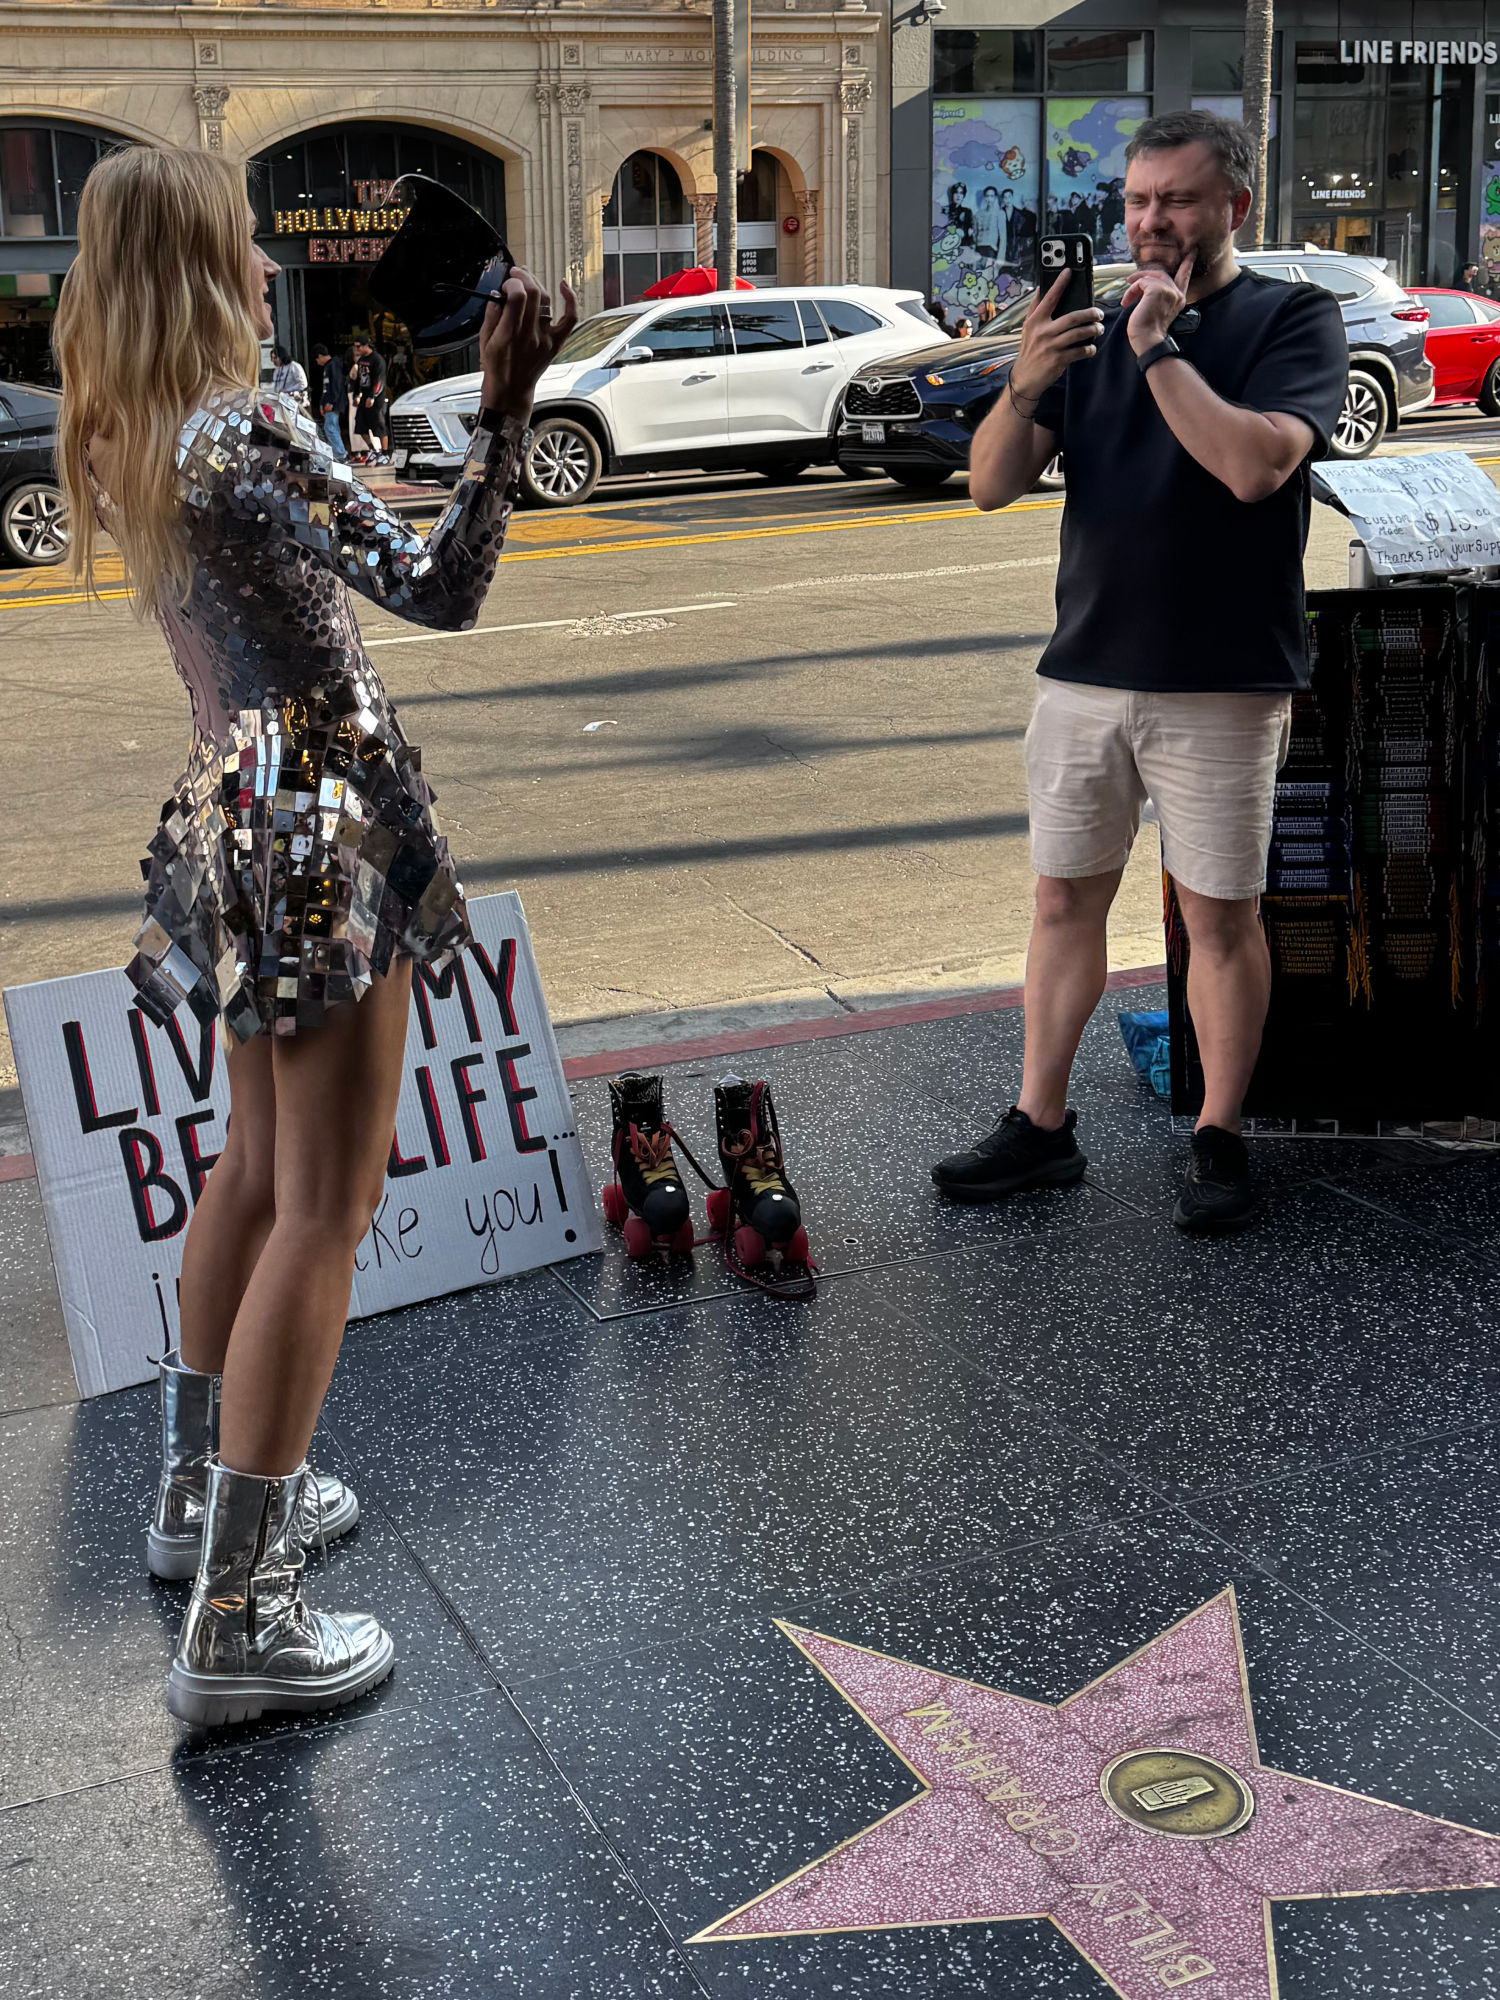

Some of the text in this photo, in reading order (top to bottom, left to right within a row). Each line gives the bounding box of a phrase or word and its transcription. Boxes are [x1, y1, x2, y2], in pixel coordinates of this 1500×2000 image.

[624, 50, 660, 62] MARY
[1340, 40, 1498, 65] LINE FRIENDS
[352, 179, 402, 205] THE
[1311, 189, 1367, 200] LINE FRIENDS
[273, 207, 411, 233] HOLLYWOO
[741, 251, 757, 259] 6912
[1376, 550, 1425, 565] Thanks
[1427, 544, 1445, 561] For
[1450, 543, 1475, 562] your
[62, 938, 520, 1135] LIV MY
[118, 1108, 232, 1244] BE
[465, 1149, 577, 1275] you!
[902, 1701, 1217, 1989] BILLY GRAHAM
